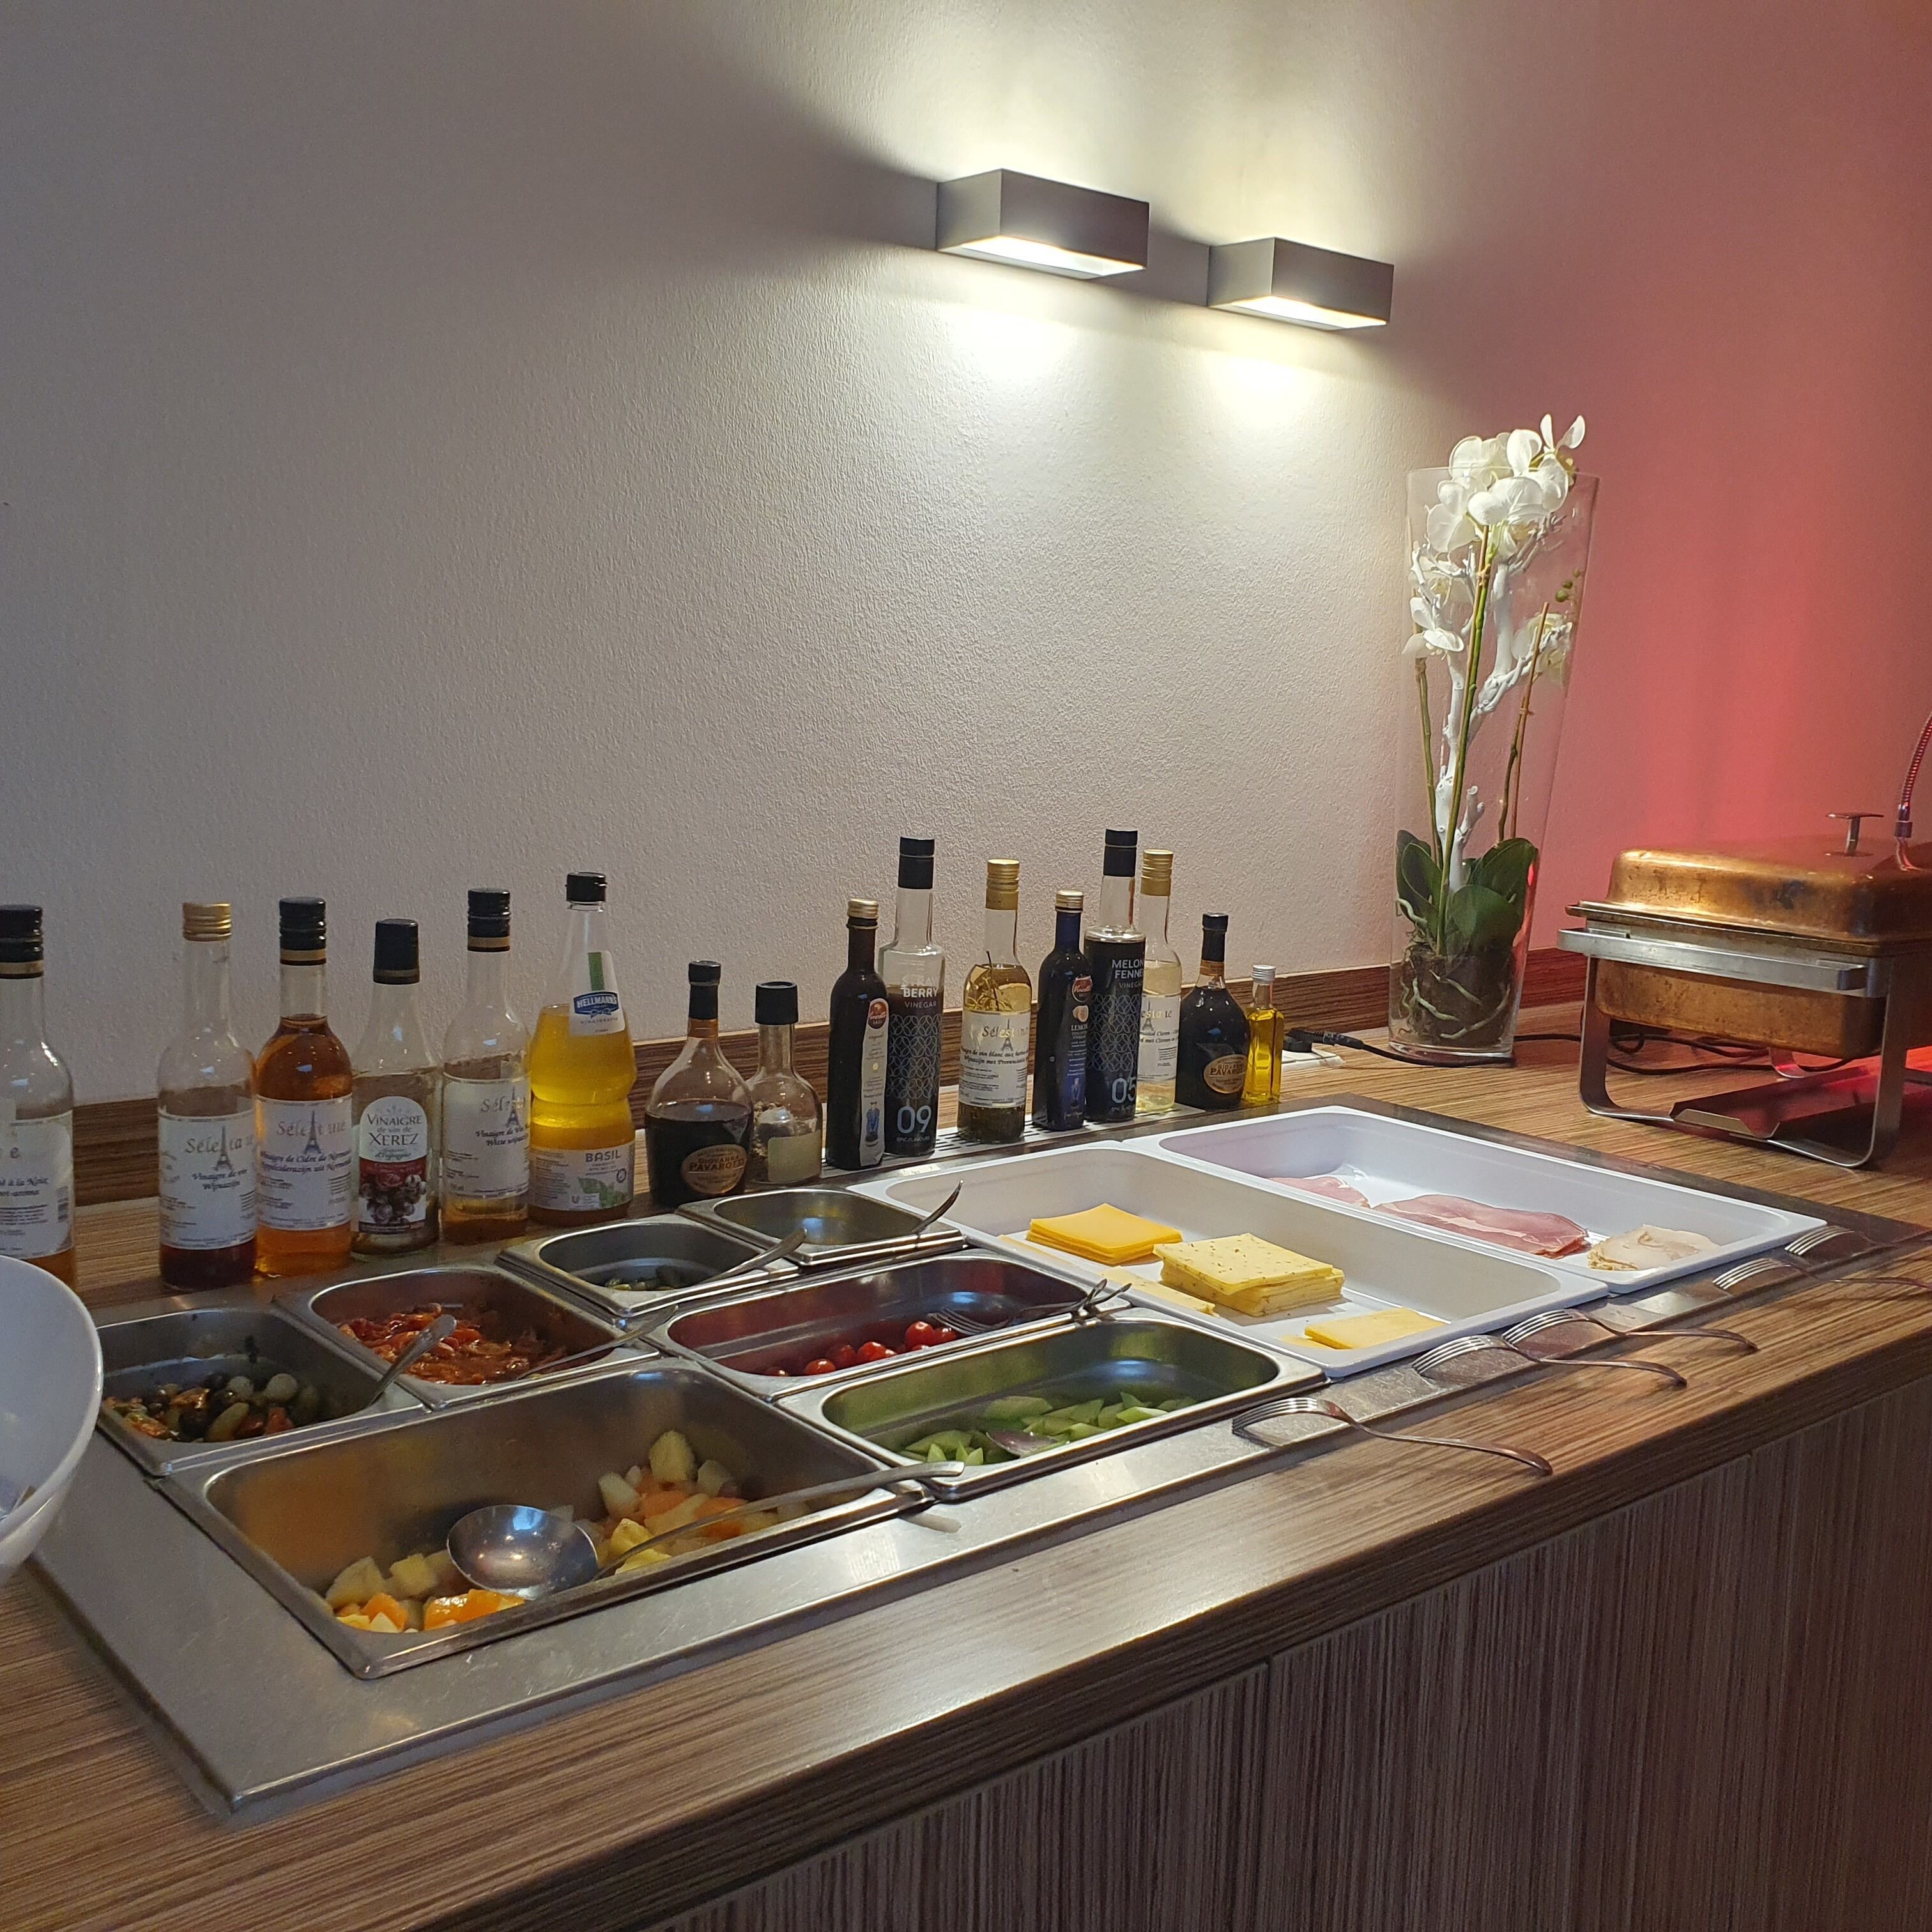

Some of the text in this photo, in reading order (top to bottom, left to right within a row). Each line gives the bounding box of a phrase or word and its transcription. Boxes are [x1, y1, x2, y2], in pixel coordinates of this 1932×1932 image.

[1112, 958, 1143, 969] MELON
[1114, 968, 1144, 979] FENNE
[903, 987, 939, 998] BERRY
[577, 995, 618, 1008] HELLMANN'S
[1112, 1077, 1136, 1103] 05
[367, 1114, 423, 1126] VINAIGRE
[896, 1105, 932, 1133] 09
[369, 1132, 419, 1146] XEREZ
[585, 1149, 621, 1163] BASIL
